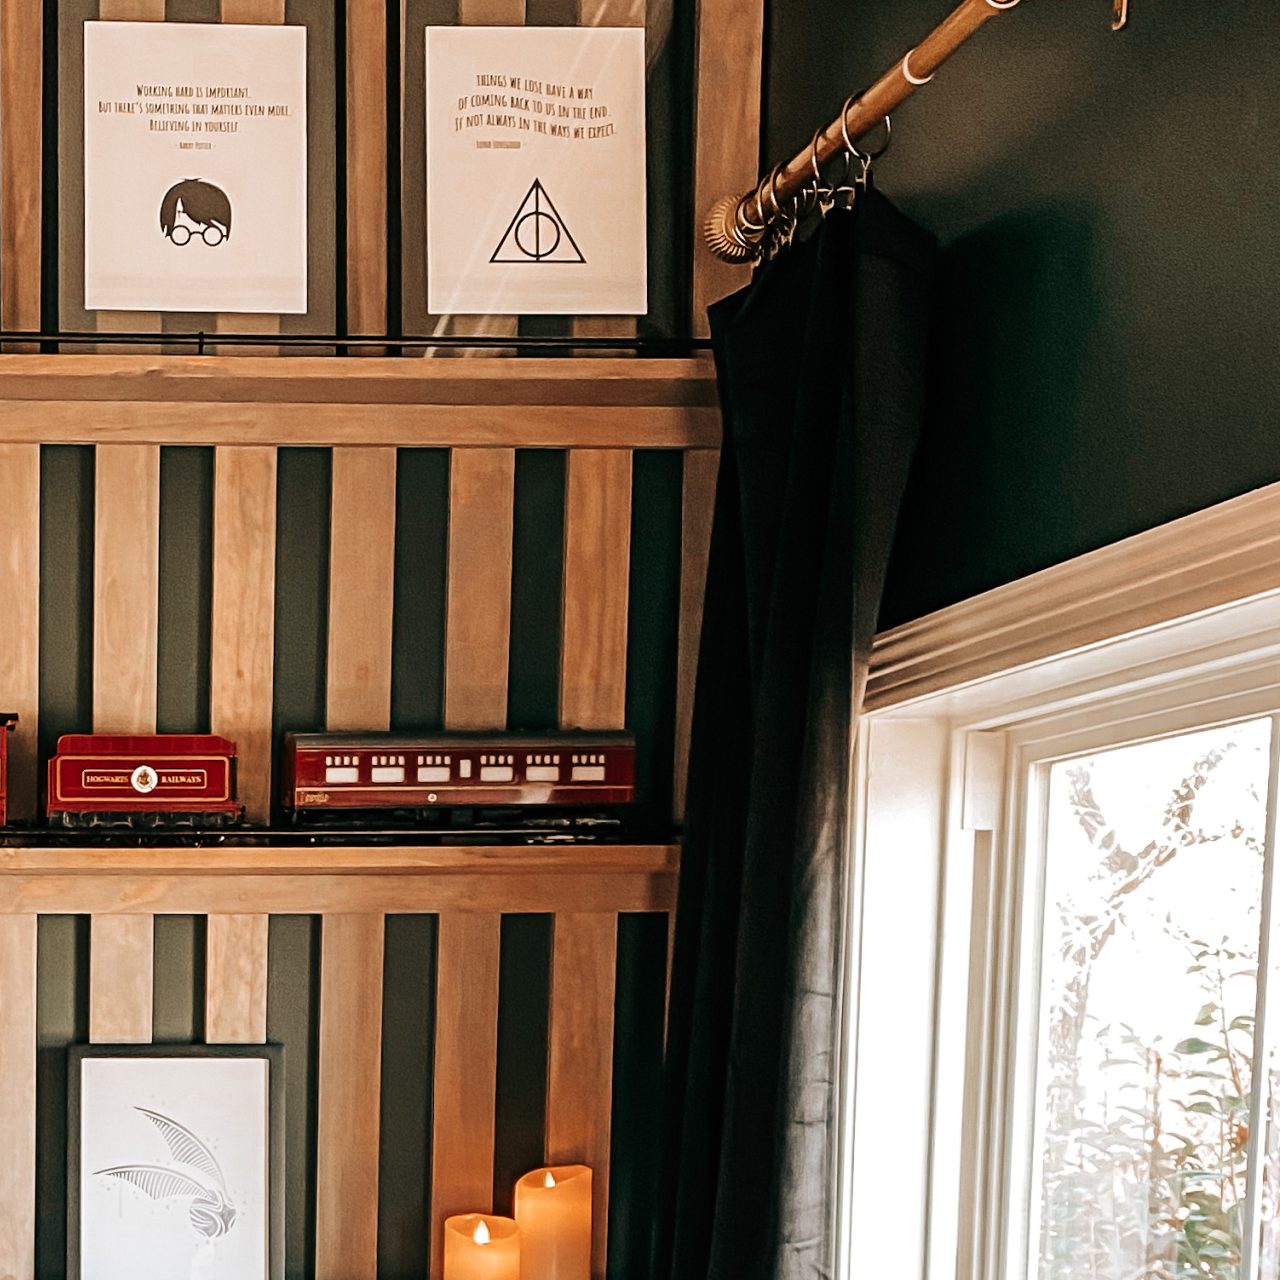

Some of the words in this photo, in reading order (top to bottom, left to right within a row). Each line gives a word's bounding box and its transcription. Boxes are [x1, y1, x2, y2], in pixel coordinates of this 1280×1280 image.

[136, 84, 173, 97] WORKING
[175, 86, 194, 98] HARD
[195, 86, 204, 98] IS
[476, 74, 507, 88] THINGS
[510, 77, 521, 90] WE
[524, 79, 542, 95] LOSE
[546, 83, 566, 99] HAVE
[568, 86, 575, 99] A
[577, 87, 593, 100] WAY
[98, 100, 112, 113] BUT
[145, 102, 190, 115] SOMETHING
[192, 103, 209, 115] THAT
[211, 104, 243, 116] MATTERS
[244, 104, 265, 116] EVEN
[458, 96, 468, 111] OF
[470, 93, 508, 108] COMING
[510, 95, 530, 111] BACK
[532, 99, 543, 114] TO
[545, 102, 556, 117] US
[558, 104, 570, 119] IN
[572, 106, 586, 120] THE
[149, 119, 190, 132] BELIEVING
[191, 121, 202, 132] IN
[455, 116, 464, 132] IF
[466, 113, 484, 128] NOT
[486, 113, 517, 129] ALWAYS
[519, 116, 531, 131] IN
[533, 119, 547, 135] THE
[550, 124, 570, 138] WAYS
[573, 126, 585, 140] WE
[86, 775, 129, 784] HOGWARTS
[161, 775, 202, 784] RAILWAYS
